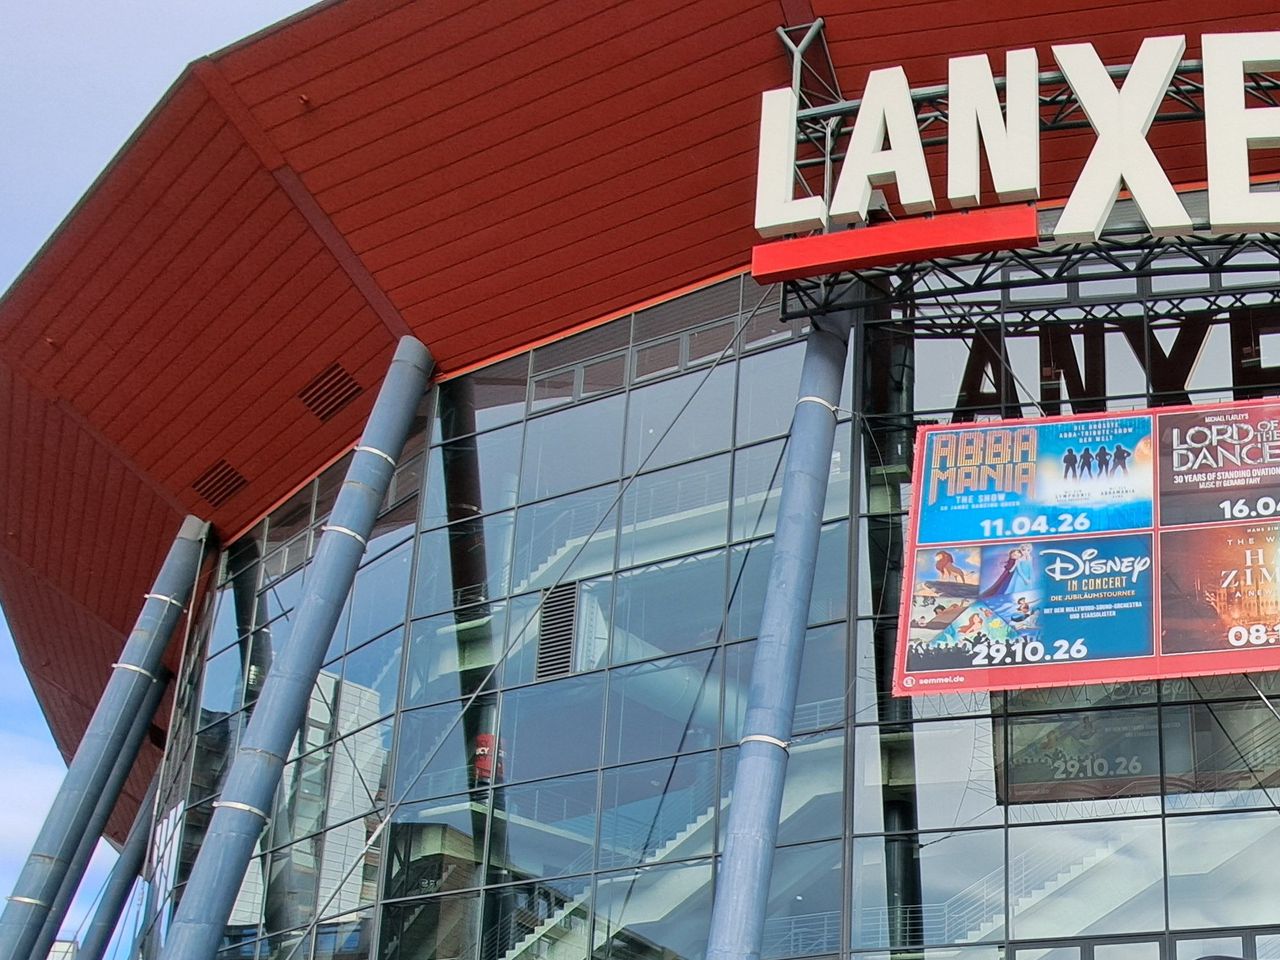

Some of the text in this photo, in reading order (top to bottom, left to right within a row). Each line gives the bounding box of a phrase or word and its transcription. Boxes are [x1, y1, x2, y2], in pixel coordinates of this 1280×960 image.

[933, 428, 1037, 467] ABBA
[1172, 420, 1279, 449] LORD OF
[929, 462, 1037, 505] MANIA
[1174, 475, 1184, 484] 30
[1184, 473, 1206, 482] YEARS
[1207, 472, 1216, 480] OF
[1217, 469, 1251, 480] STANDING
[956, 493, 1006, 504] THE SHOW
[980, 512, 1091, 537] 11.04.26
[1039, 548, 1151, 583] Disney
[1067, 576, 1127, 591] IN CONCERT
[972, 638, 1088, 665] 29.10.26
[919, 675, 965, 685] semmel.de
